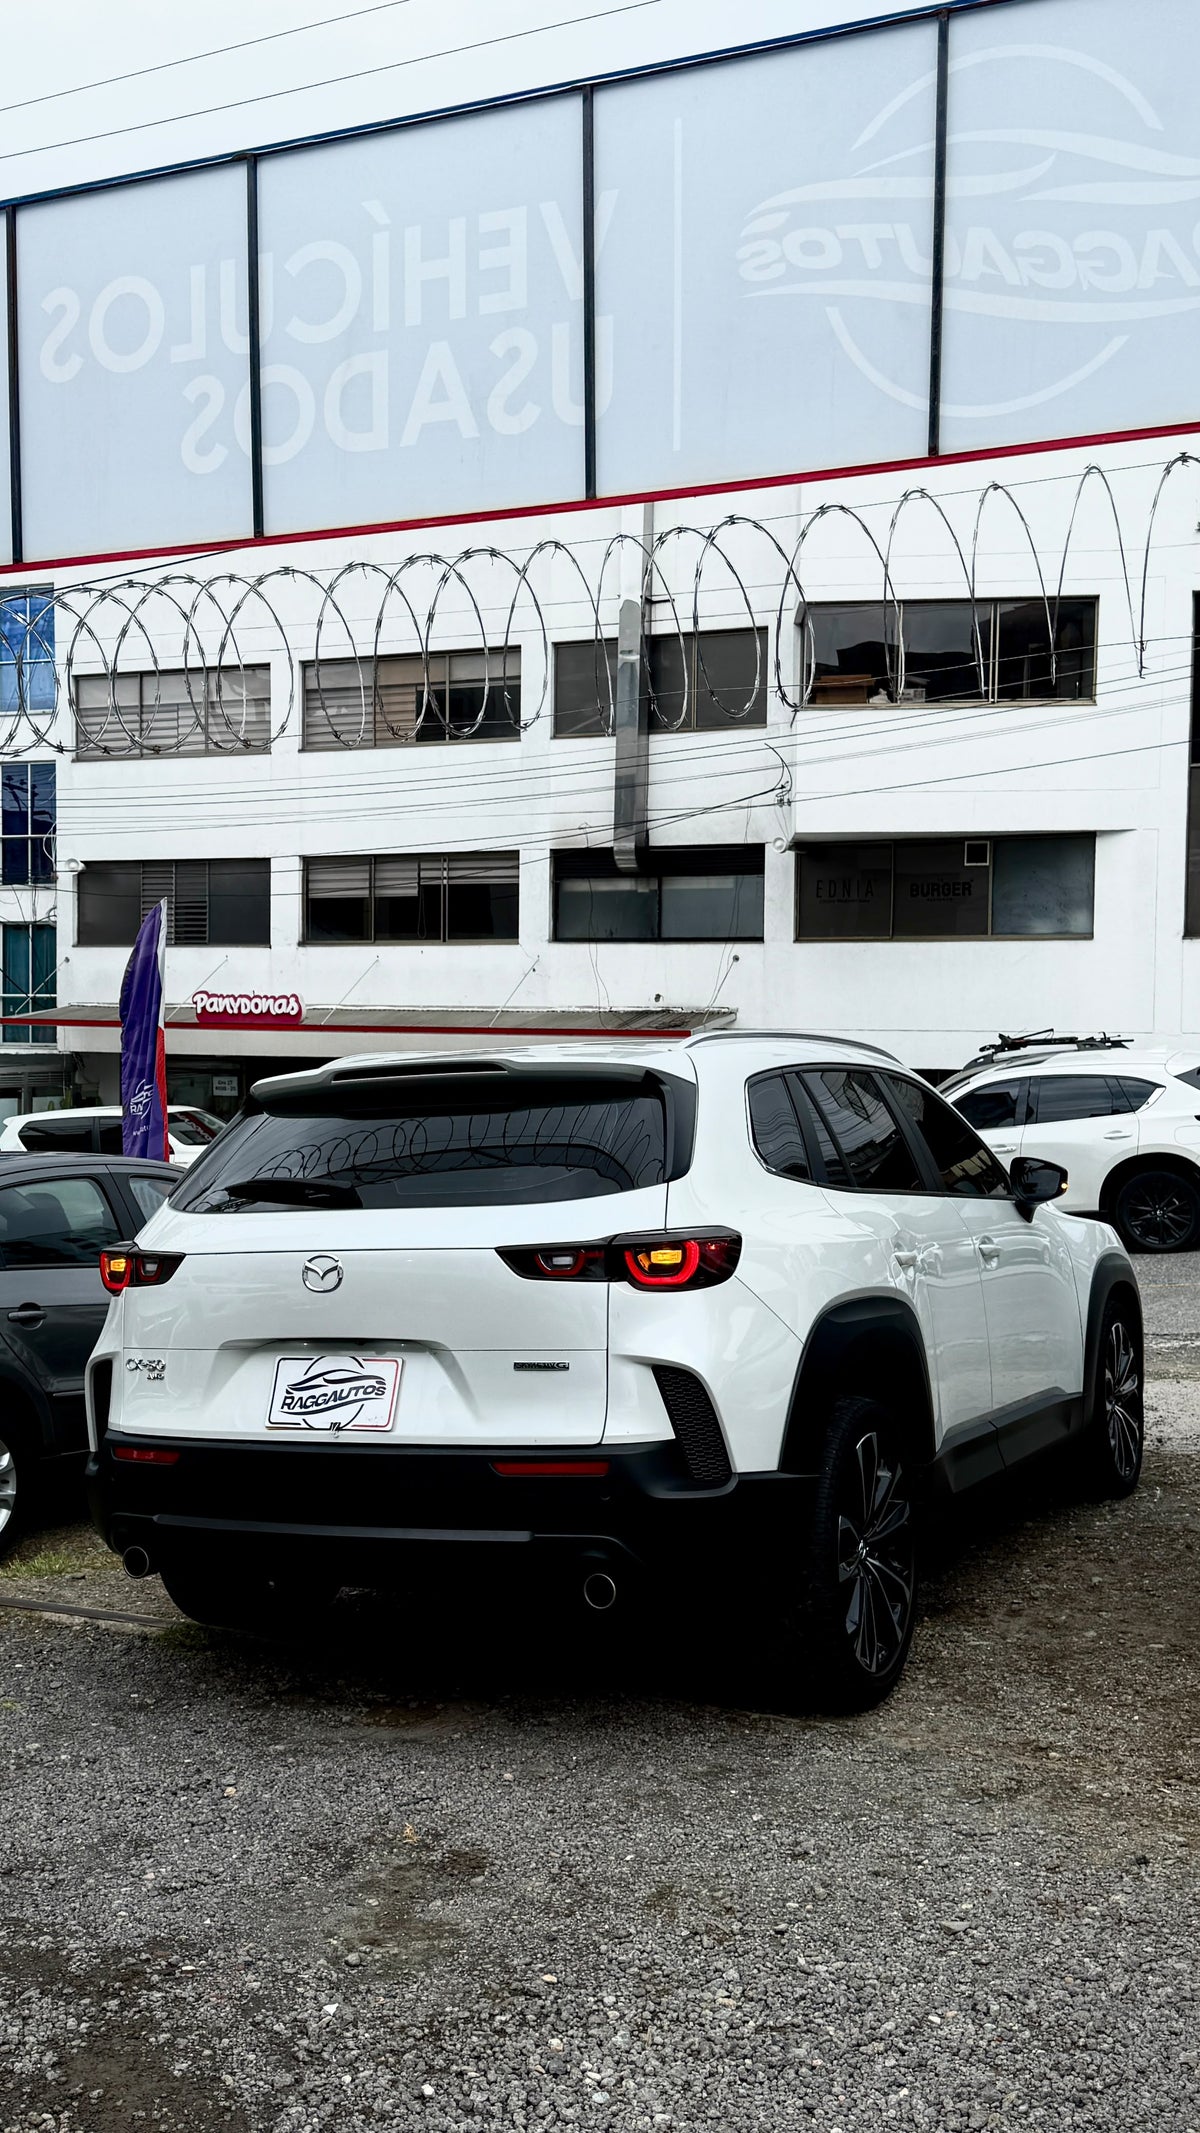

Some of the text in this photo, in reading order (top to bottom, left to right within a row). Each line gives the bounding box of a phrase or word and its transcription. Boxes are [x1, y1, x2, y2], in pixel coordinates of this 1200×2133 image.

[815, 879, 874, 898] EDNIA
[909, 881, 972, 898] BURGER
[126, 1358, 167, 1372] CX-50
[280, 1385, 387, 1410] RAGGAUTOS
